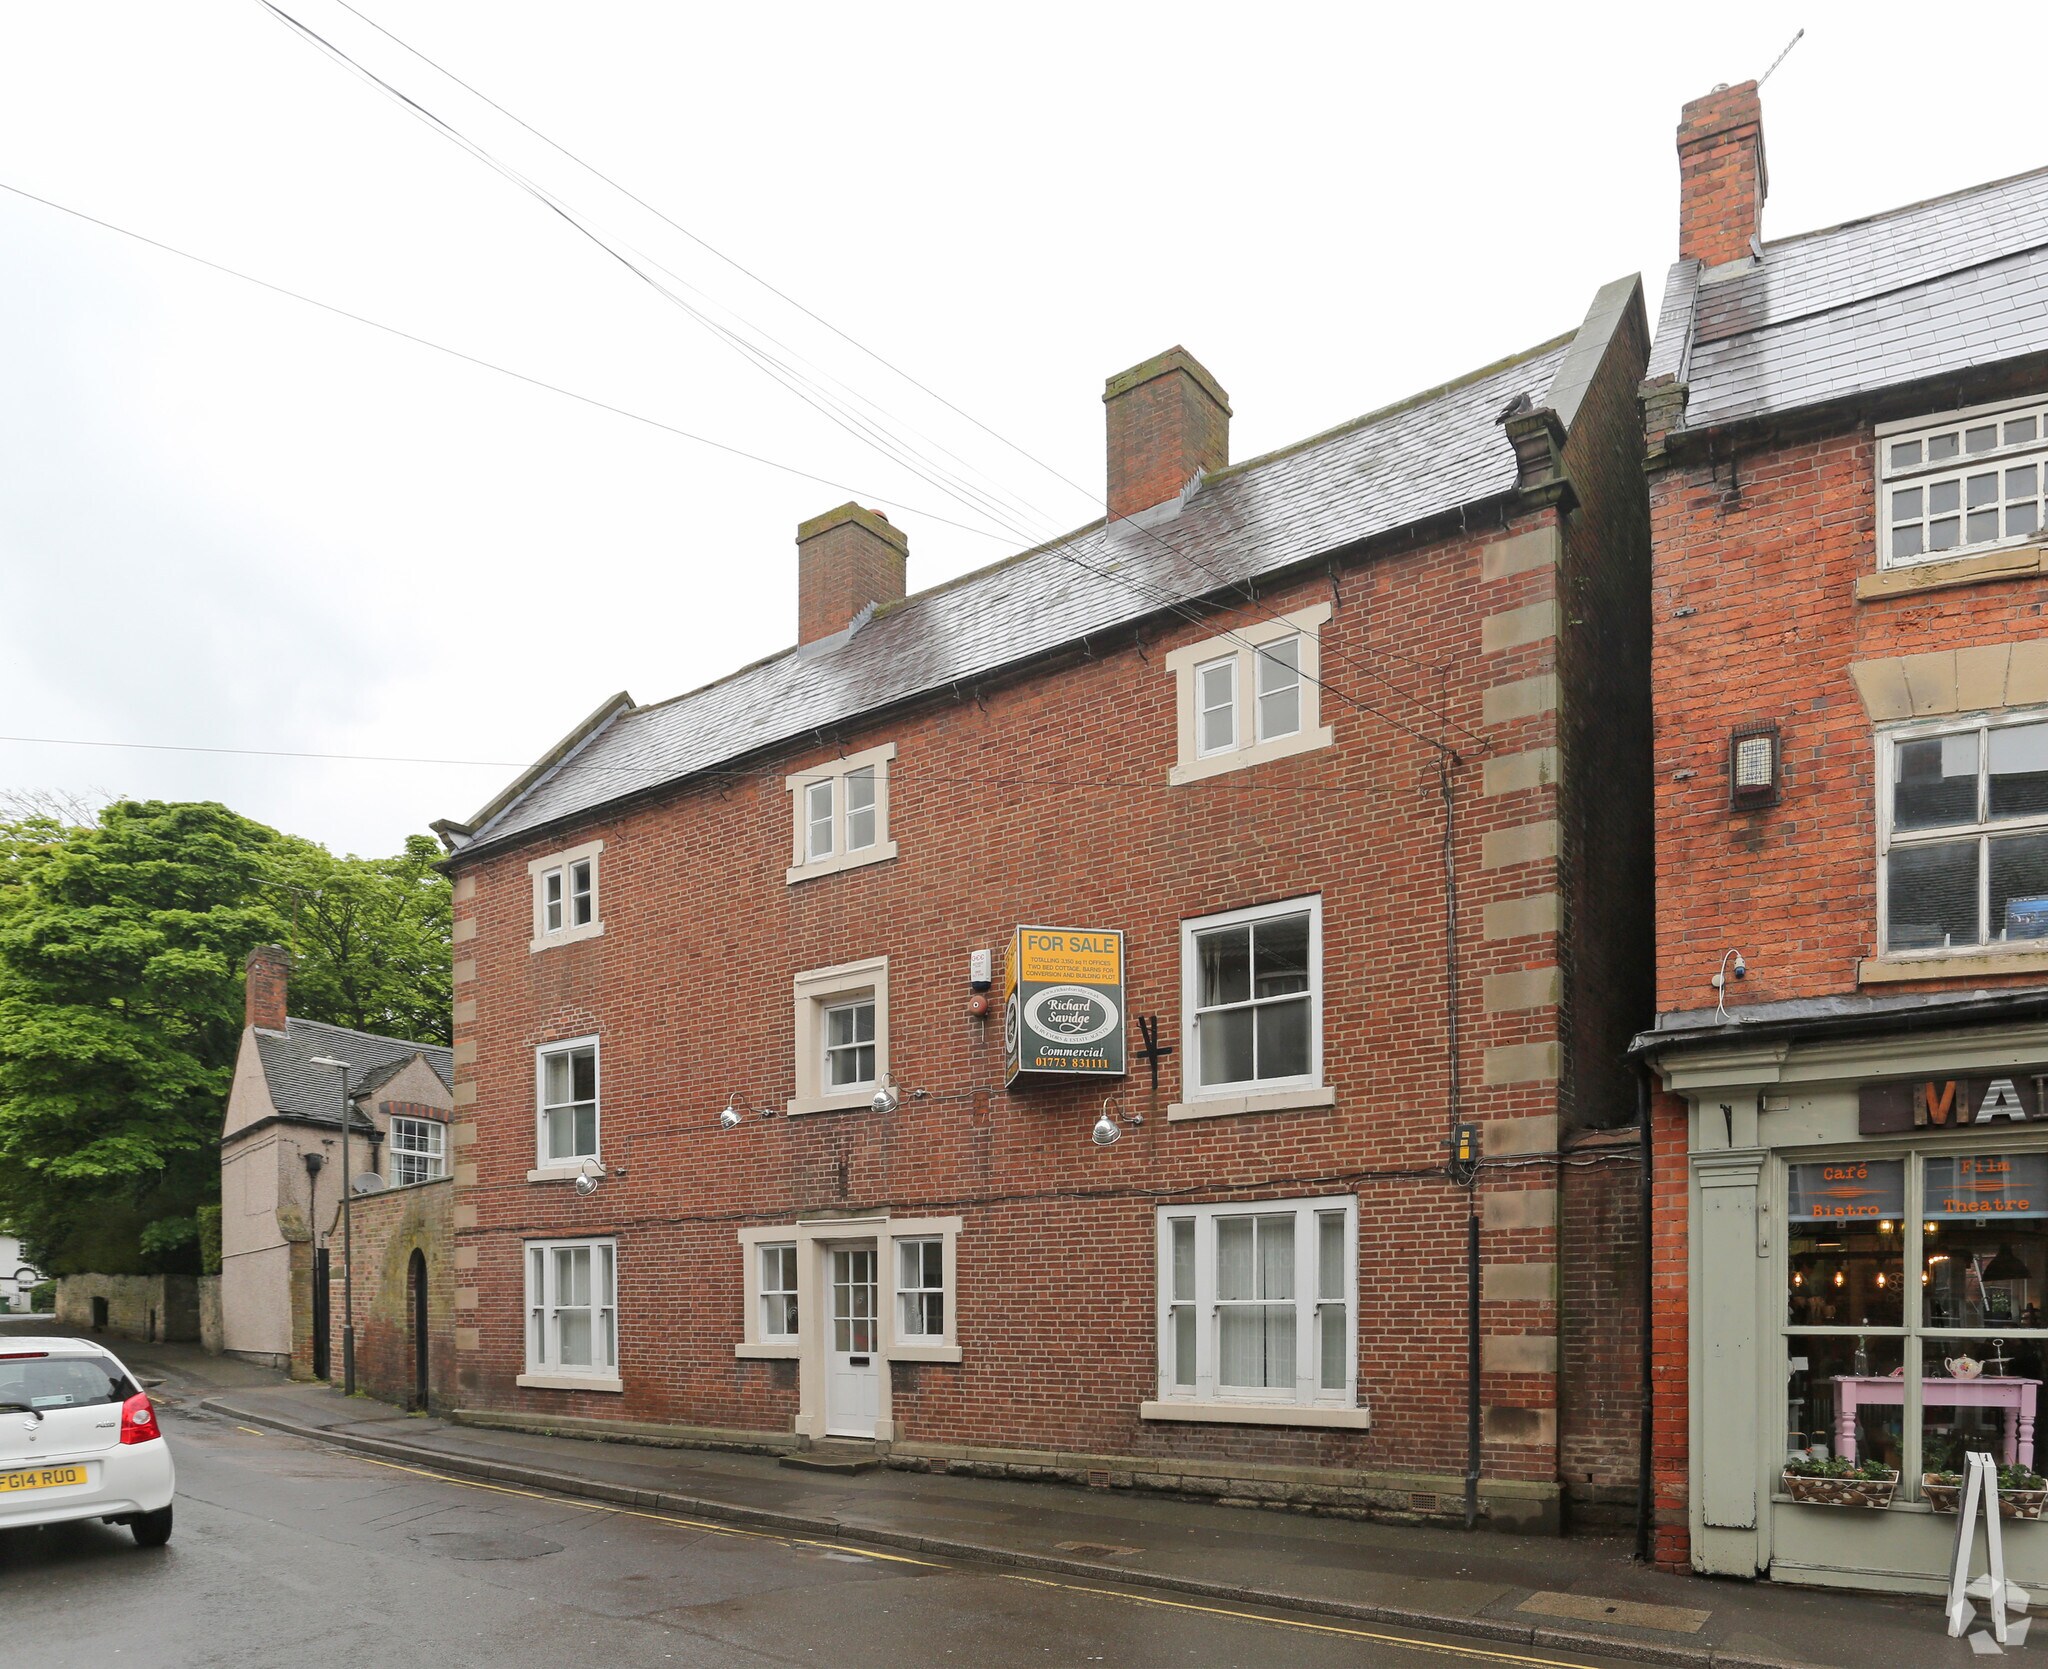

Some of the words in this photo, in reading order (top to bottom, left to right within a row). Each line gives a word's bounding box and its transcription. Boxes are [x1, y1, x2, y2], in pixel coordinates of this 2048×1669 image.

[1028, 935, 1063, 951] FOR
[1069, 937, 1114, 954] SALE
[1047, 999, 1090, 1011] Richard
[1048, 1012, 1090, 1033] Savidge
[1034, 1025, 1062, 1041] SURVEYORS
[1090, 1027, 1109, 1039] AGENTS
[1040, 1046, 1103, 1057] Commercial
[1036, 1057, 1066, 1067] 01773
[1072, 1058, 1108, 1068] 831111
[1823, 1163, 1868, 1181] Café
[1961, 1159, 2011, 1174] Film
[1812, 1204, 1880, 1218] Bistro
[1943, 1199, 2030, 1213] Theatre
[0, 1474, 36, 1488] FG14
[41, 1469, 77, 1485] RUO
